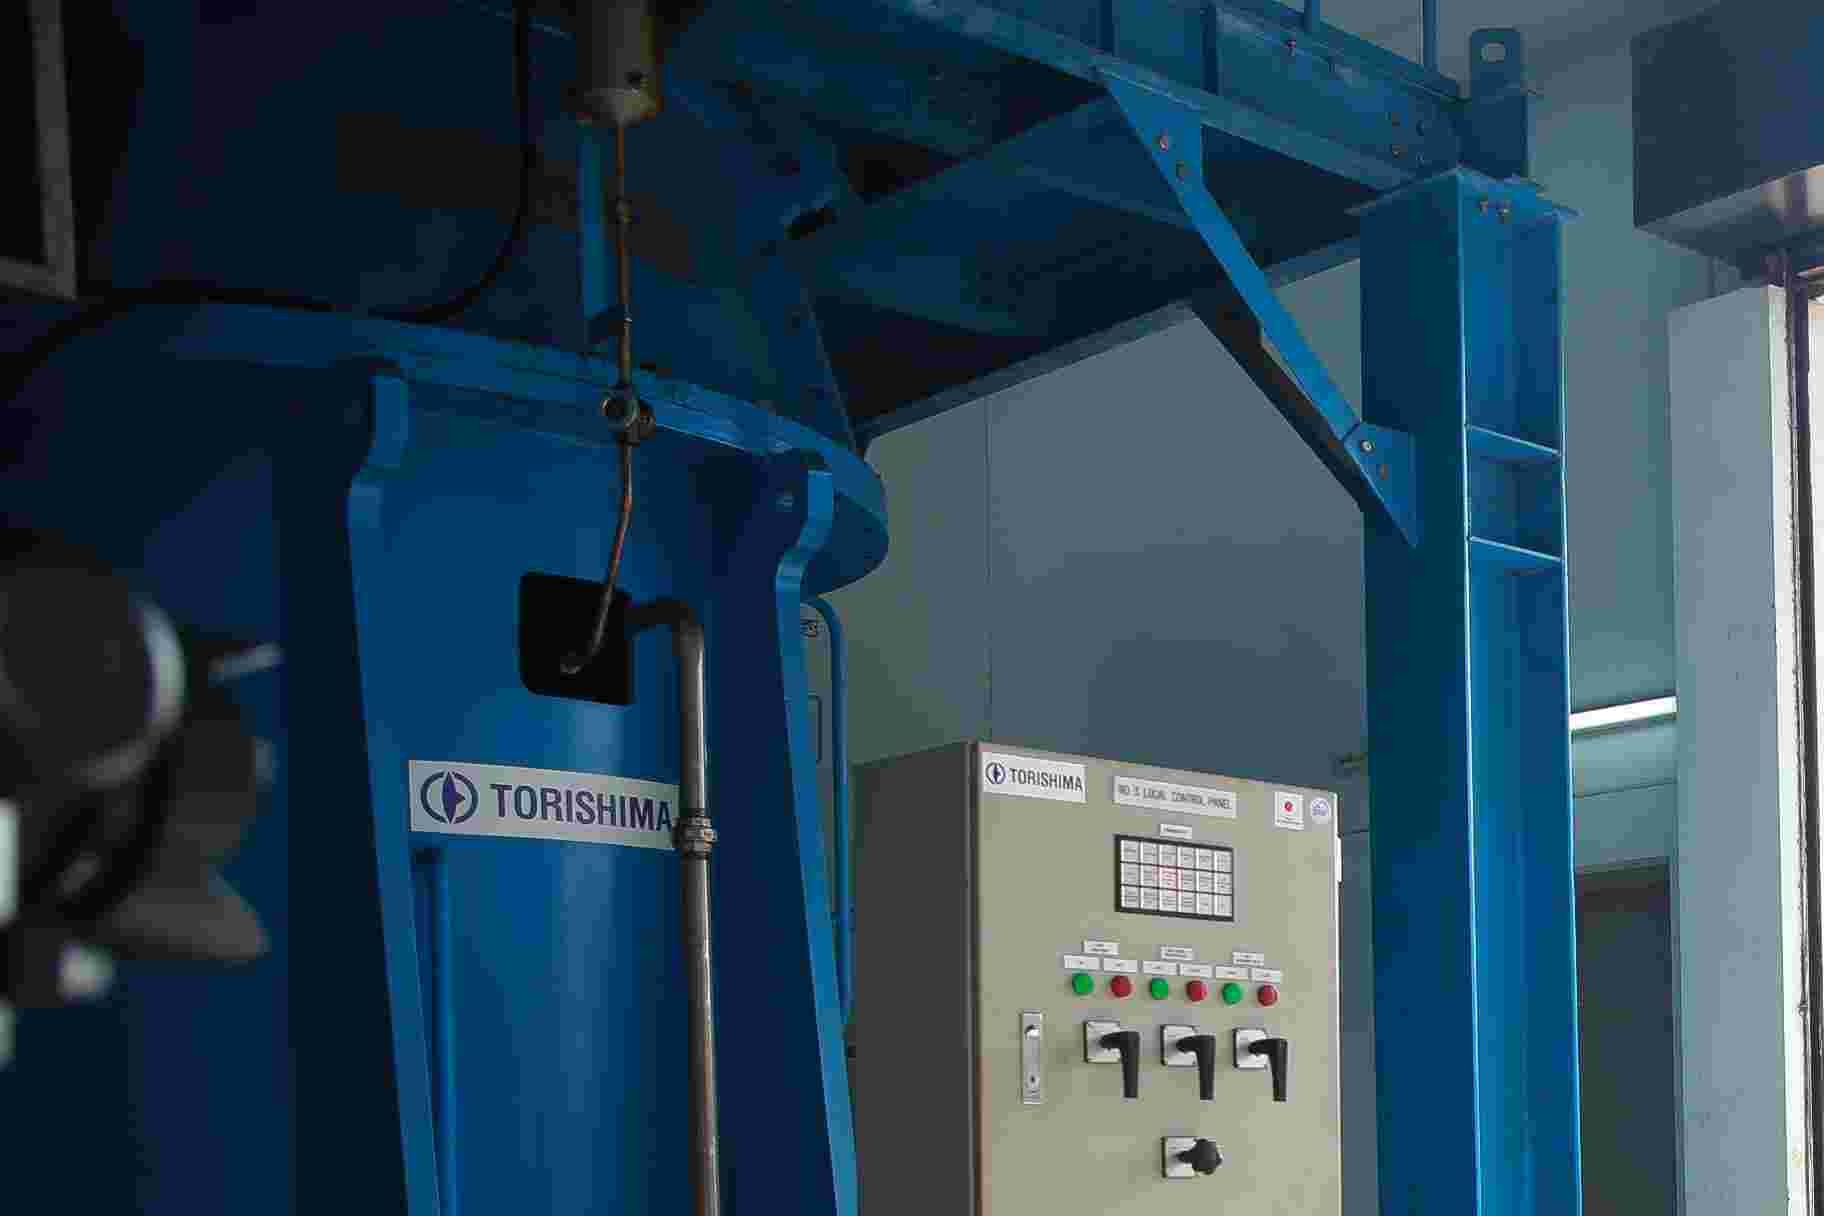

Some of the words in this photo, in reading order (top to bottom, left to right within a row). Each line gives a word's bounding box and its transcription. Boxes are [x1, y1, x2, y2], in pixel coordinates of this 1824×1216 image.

[1009, 767, 1083, 792] TORISHIMA
[490, 783, 673, 831] TORISHIMA
[1207, 796, 1233, 809] PANEL
